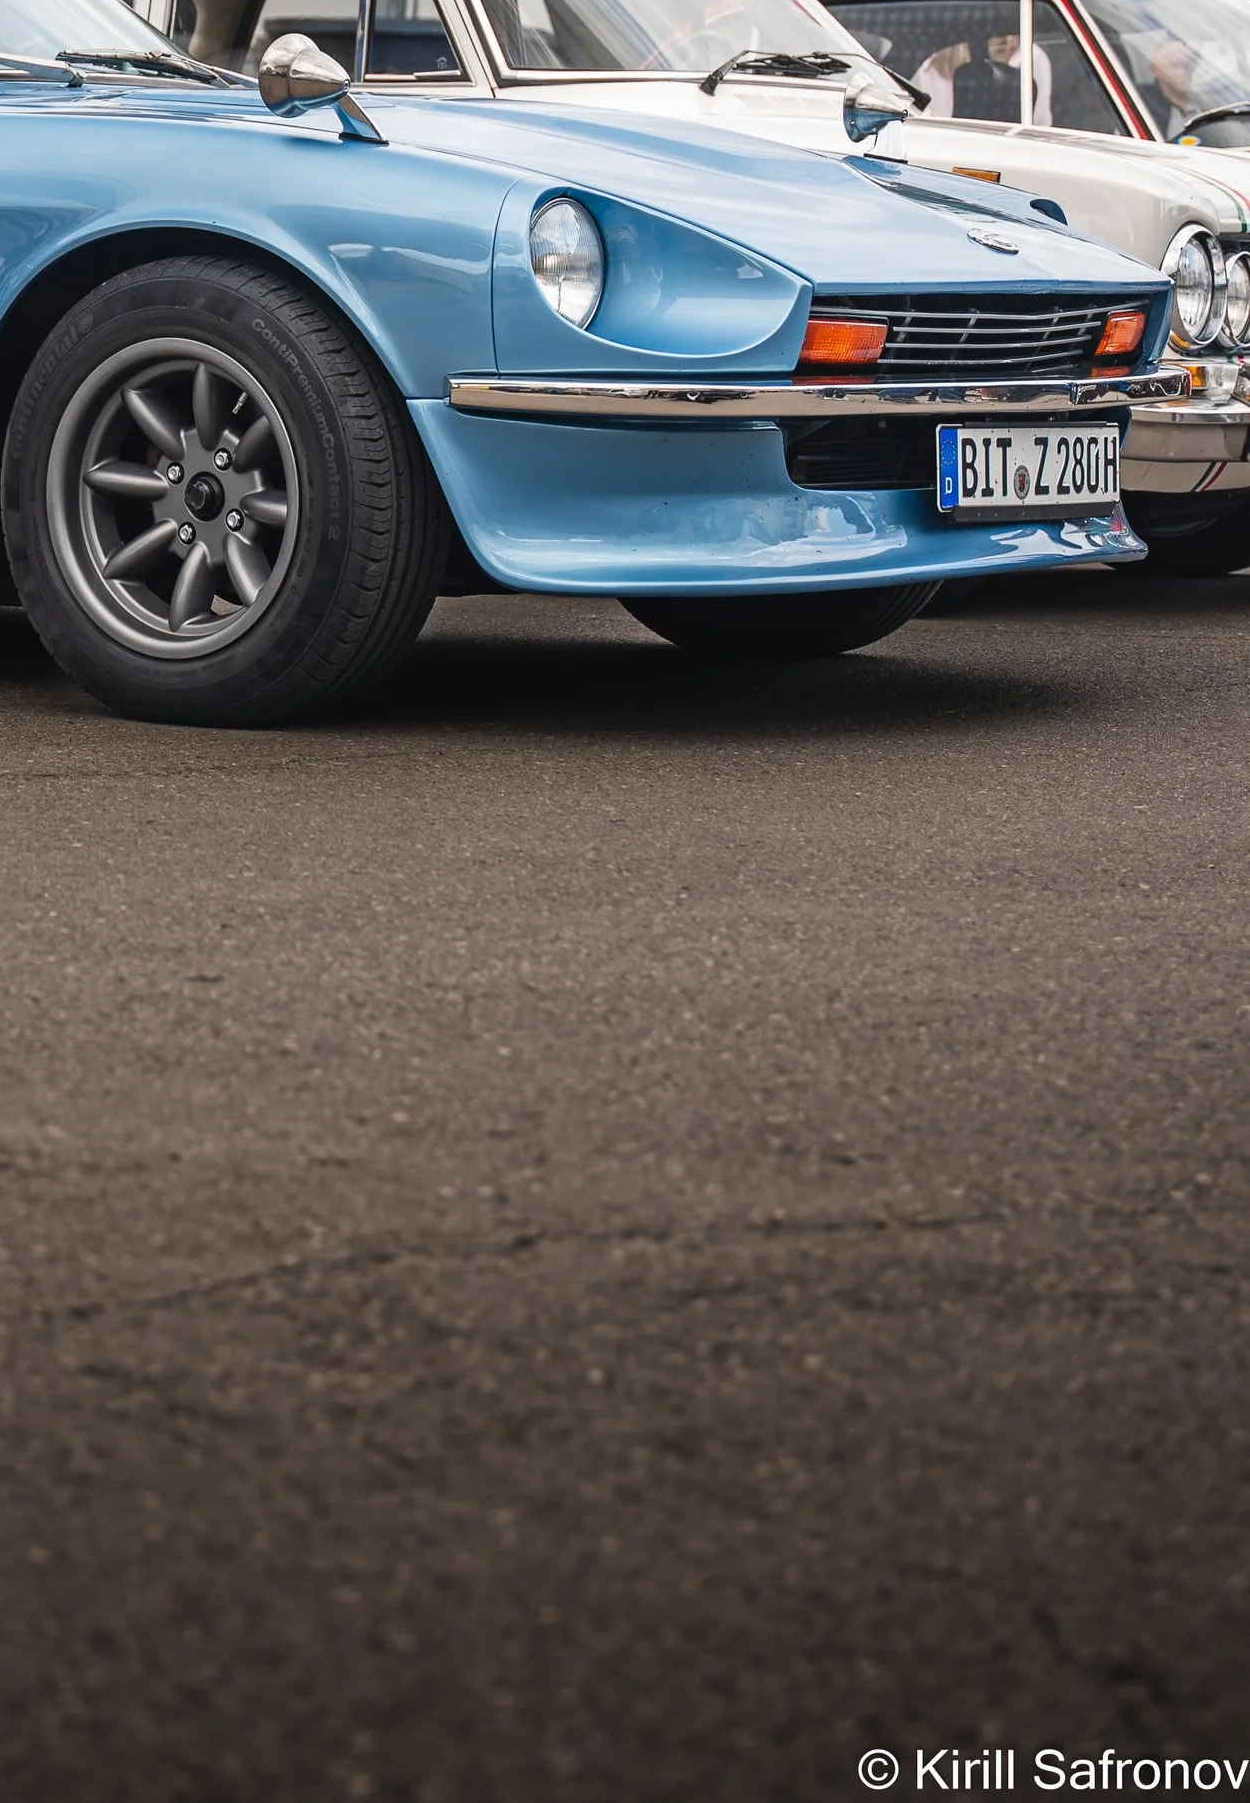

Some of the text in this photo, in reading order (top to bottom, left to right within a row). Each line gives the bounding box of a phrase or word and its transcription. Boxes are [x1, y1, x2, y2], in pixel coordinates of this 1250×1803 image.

[961, 437, 1012, 498] BIT
[945, 477, 953, 494] D
[328, 524, 341, 541] 2
